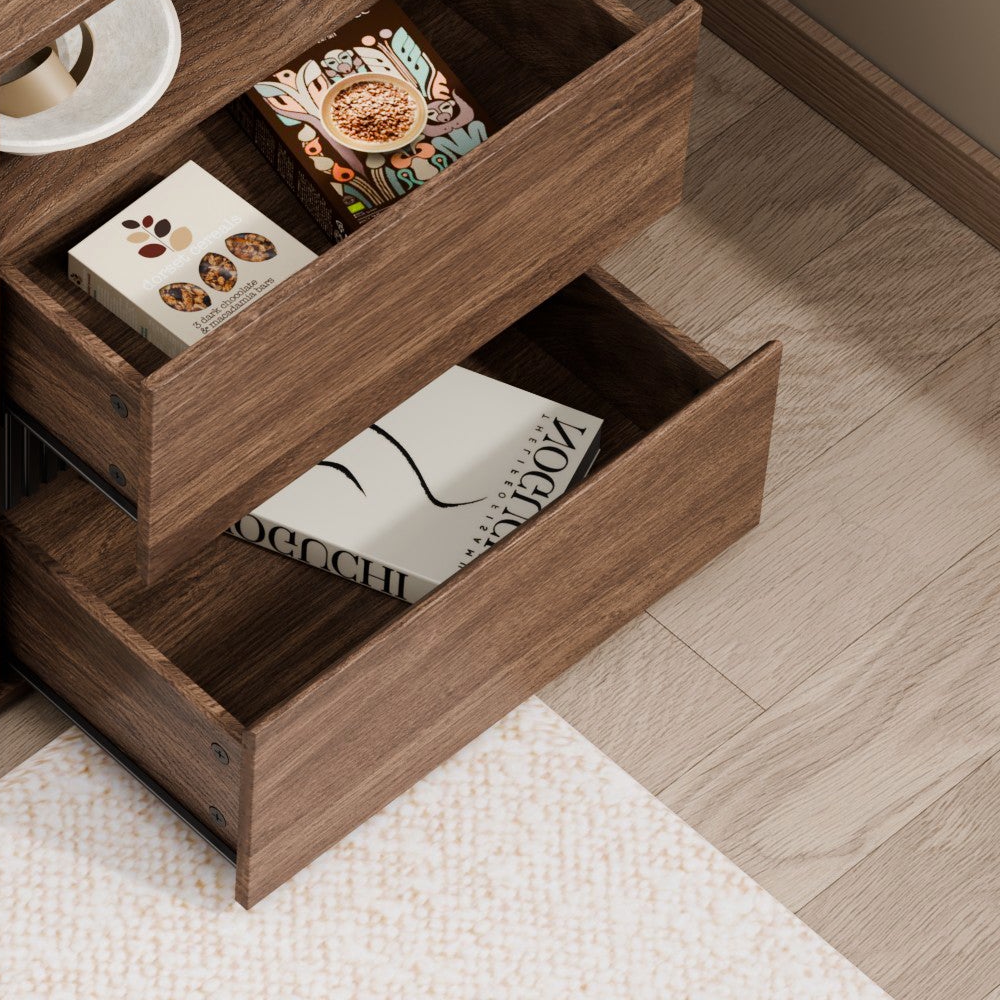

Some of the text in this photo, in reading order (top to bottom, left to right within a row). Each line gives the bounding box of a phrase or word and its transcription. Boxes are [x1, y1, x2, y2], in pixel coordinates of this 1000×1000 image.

[143, 215, 242, 290] dorset cereals
[192, 279, 258, 329] 3 dark chocolate
[200, 277, 275, 335] & macadamia bars
